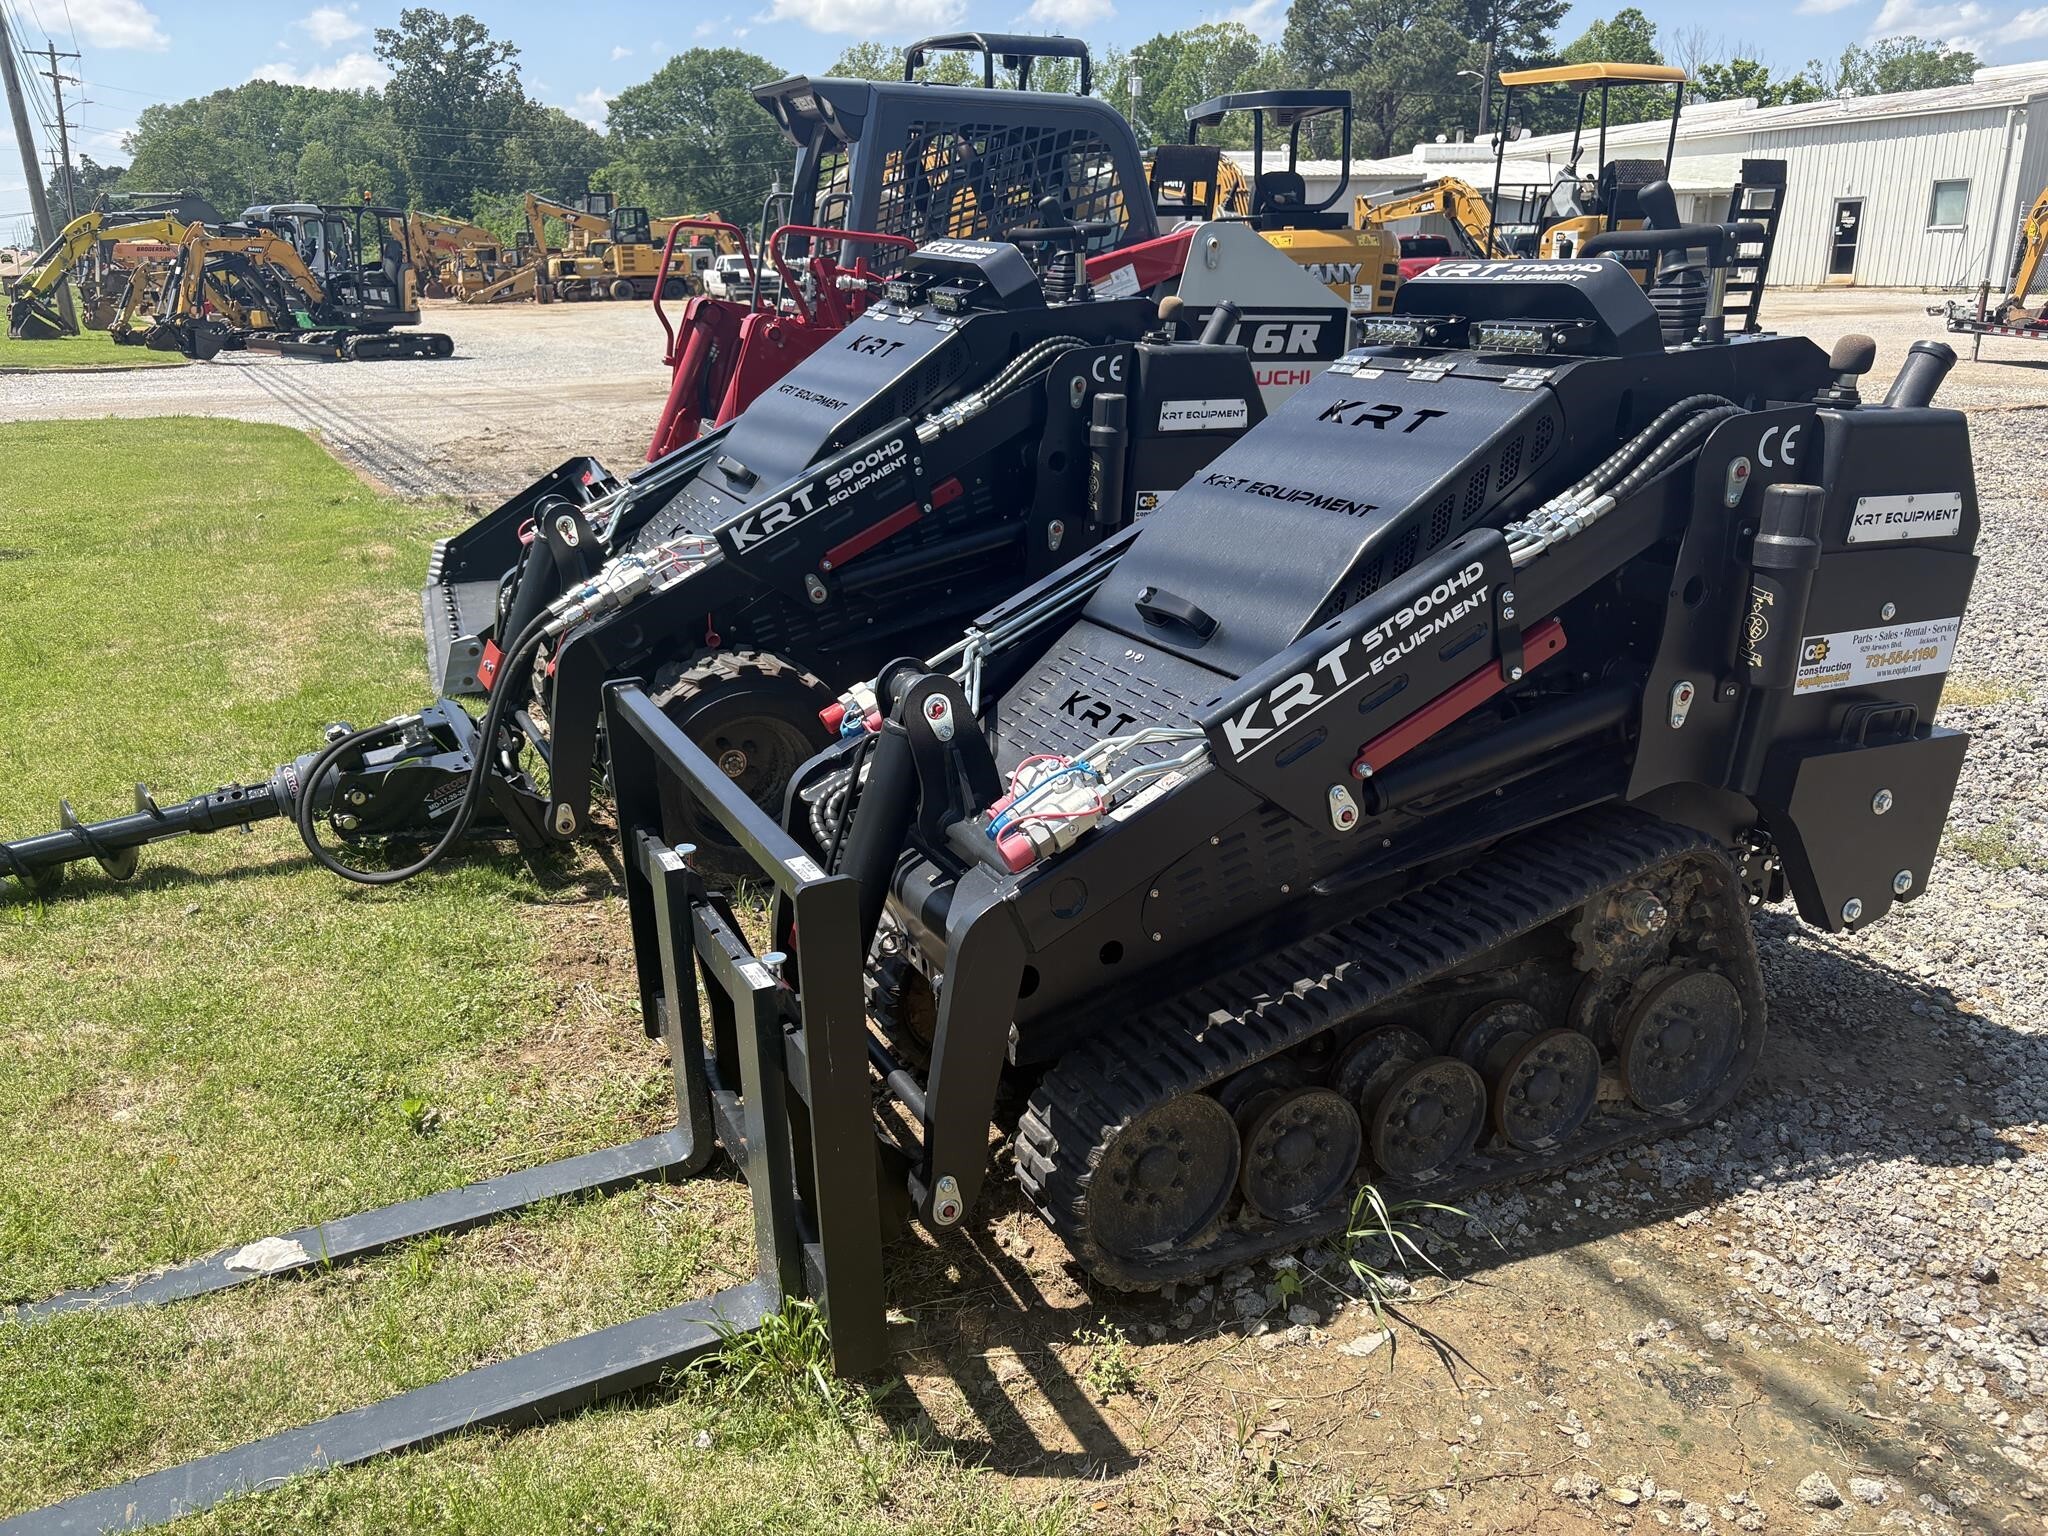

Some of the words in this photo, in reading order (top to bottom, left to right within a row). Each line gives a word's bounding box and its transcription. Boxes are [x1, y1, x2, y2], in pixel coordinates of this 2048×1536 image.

[920, 241, 965, 253] KRT
[1298, 263, 1362, 284] ANY
[1420, 263, 1513, 277] KRT
[846, 334, 906, 358] KRT
[1256, 370, 1310, 386] UCHI
[777, 383, 799, 395] KRT
[793, 388, 848, 411] EQUIPMENT
[1161, 411, 1183, 420] KRT
[1187, 409, 1245, 419] EQUIPMENT
[1317, 399, 1448, 433] KRT
[828, 454, 909, 506] EQUIPMENT
[728, 483, 814, 551] KRT
[825, 439, 904, 491] S900HD
[1202, 473, 1246, 489] KRT
[1246, 482, 1380, 518] EQUIPMENT
[1854, 513, 1882, 526] KRT
[1885, 508, 1959, 524] EQUIPMENT
[1369, 584, 1489, 674] EQUIPMENT
[1852, 634, 1873, 645] Parts
[1878, 630, 1898, 642] Sales
[1904, 626, 1927, 638] Rental
[1932, 622, 1957, 634] Service
[1222, 639, 1352, 755] KRT
[1361, 561, 1484, 650] ST900HD
[1798, 661, 1851, 676] construction
[1796, 671, 1850, 688] equipment
[1059, 689, 1137, 735] KRT
